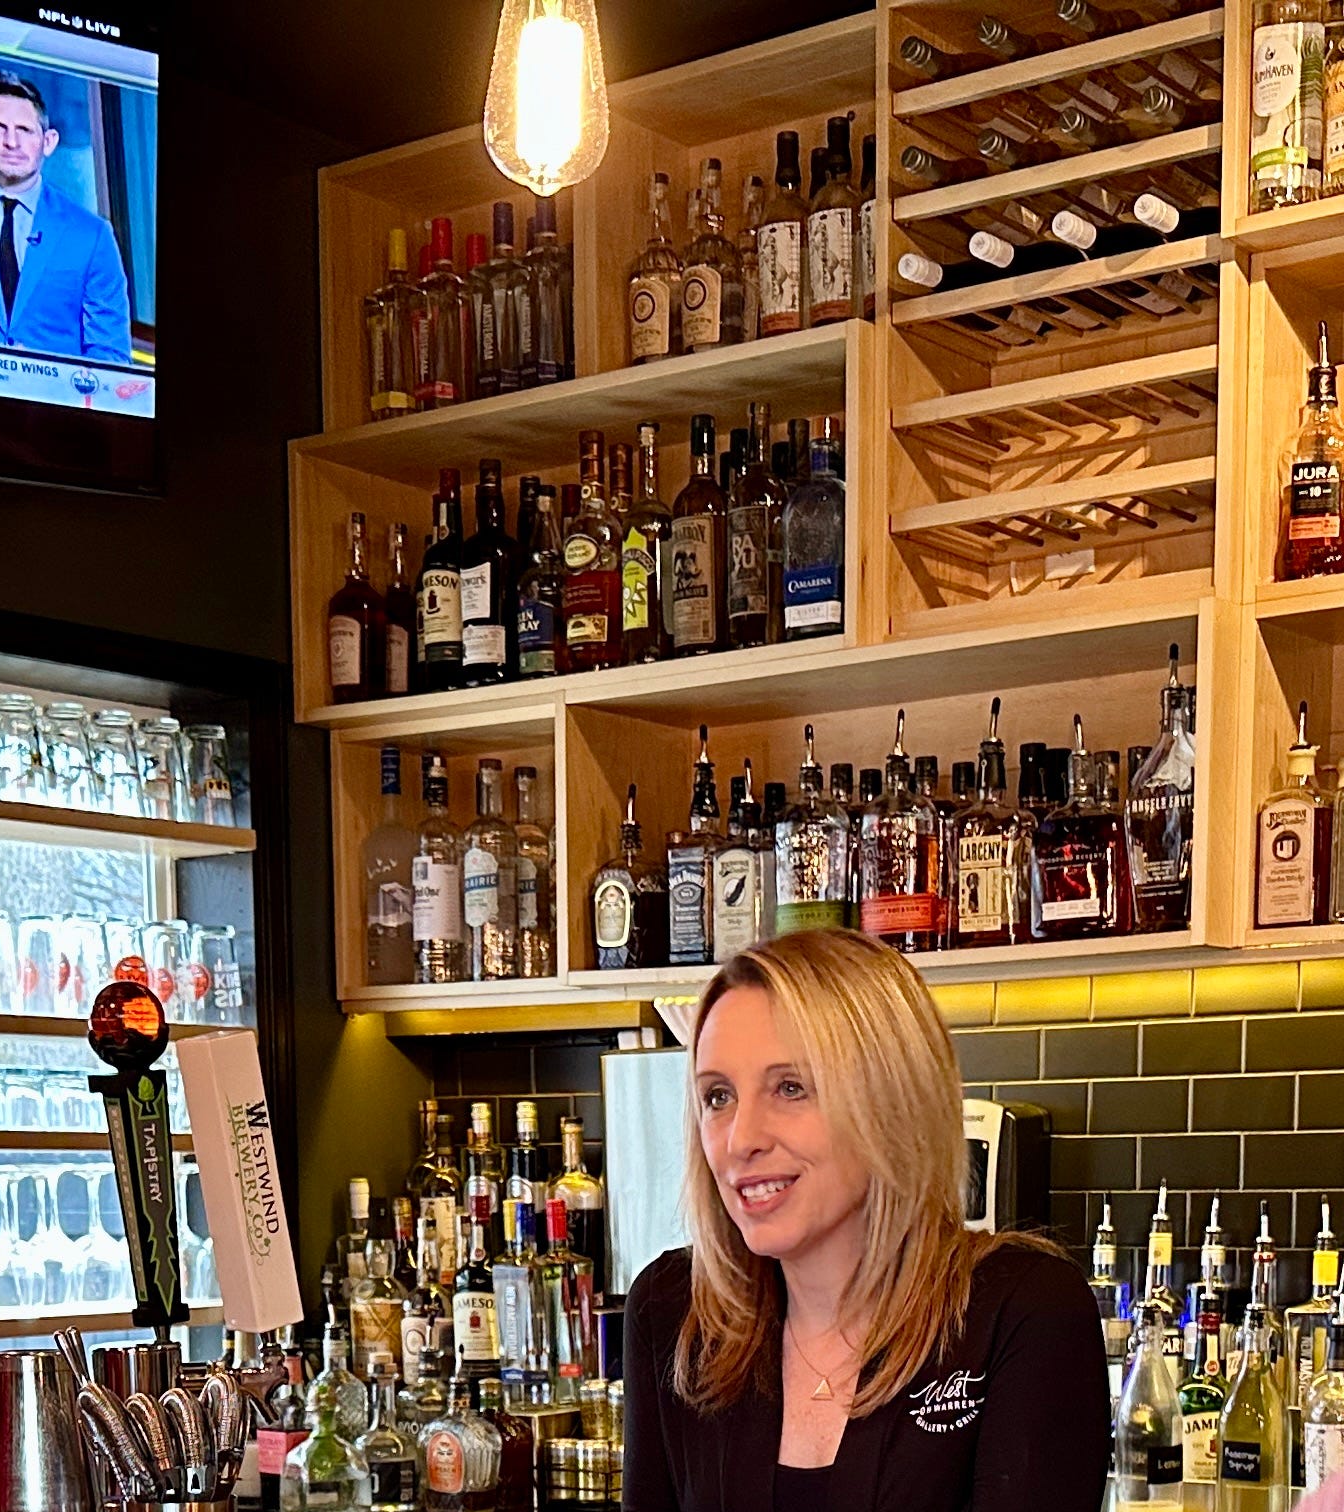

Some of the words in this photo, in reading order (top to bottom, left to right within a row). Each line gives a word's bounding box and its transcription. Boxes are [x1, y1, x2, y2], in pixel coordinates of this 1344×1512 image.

[39, 8, 71, 26] NFL
[86, 20, 121, 37] LIVE
[20, 362, 60, 379] WINGS
[1293, 466, 1340, 481] JURA
[424, 574, 459, 590] MESON
[788, 577, 832, 594] CAMARENA
[960, 841, 1001, 863] LARCENY
[465, 875, 497, 890] RAIRIE
[143, 1122, 163, 1204] TAPISTRY
[232, 1104, 261, 1205] BREWERY
[245, 1100, 280, 1235] WESTWIND
[456, 1297, 495, 1310] AMESO
[909, 1369, 987, 1406] West
[919, 1405, 933, 1416] ON
[933, 1399, 976, 1413] WARREN
[915, 1415, 948, 1433] GALLERY
[955, 1409, 979, 1428] GRILL
